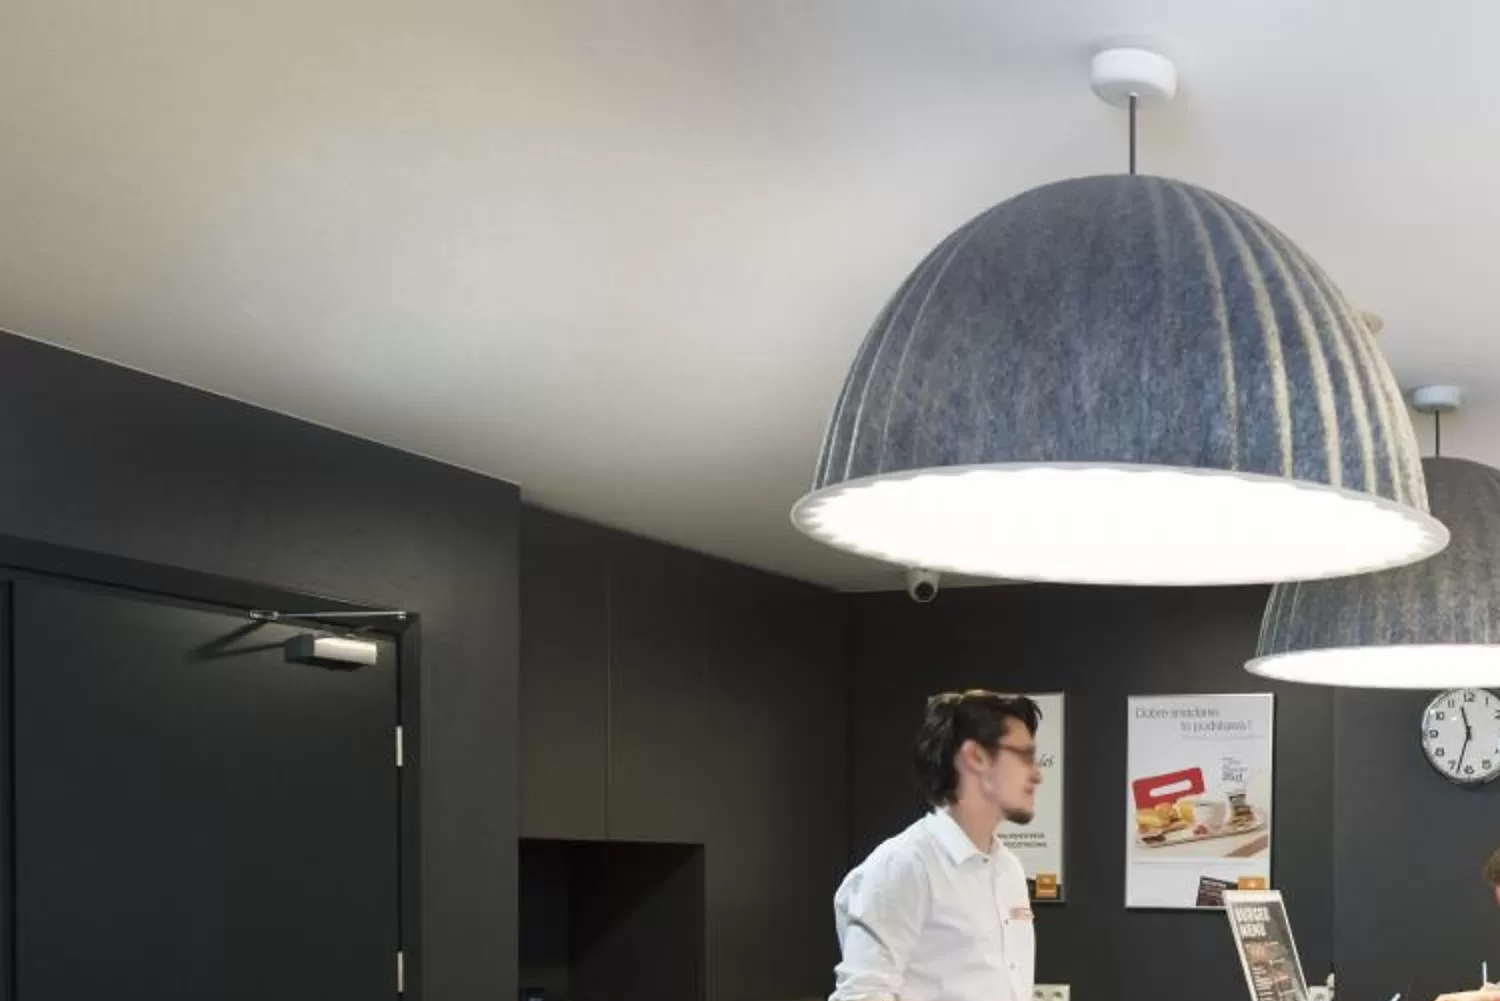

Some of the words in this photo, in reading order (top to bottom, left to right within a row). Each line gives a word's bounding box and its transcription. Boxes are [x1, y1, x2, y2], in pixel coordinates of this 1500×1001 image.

[1463, 692, 1475, 702] 12
[1447, 699, 1455, 708] 11
[1429, 729, 1439, 738] 9
[1435, 748, 1445, 757] 8
[1464, 765, 1475, 774] 6
[1481, 760, 1492, 770] 5
